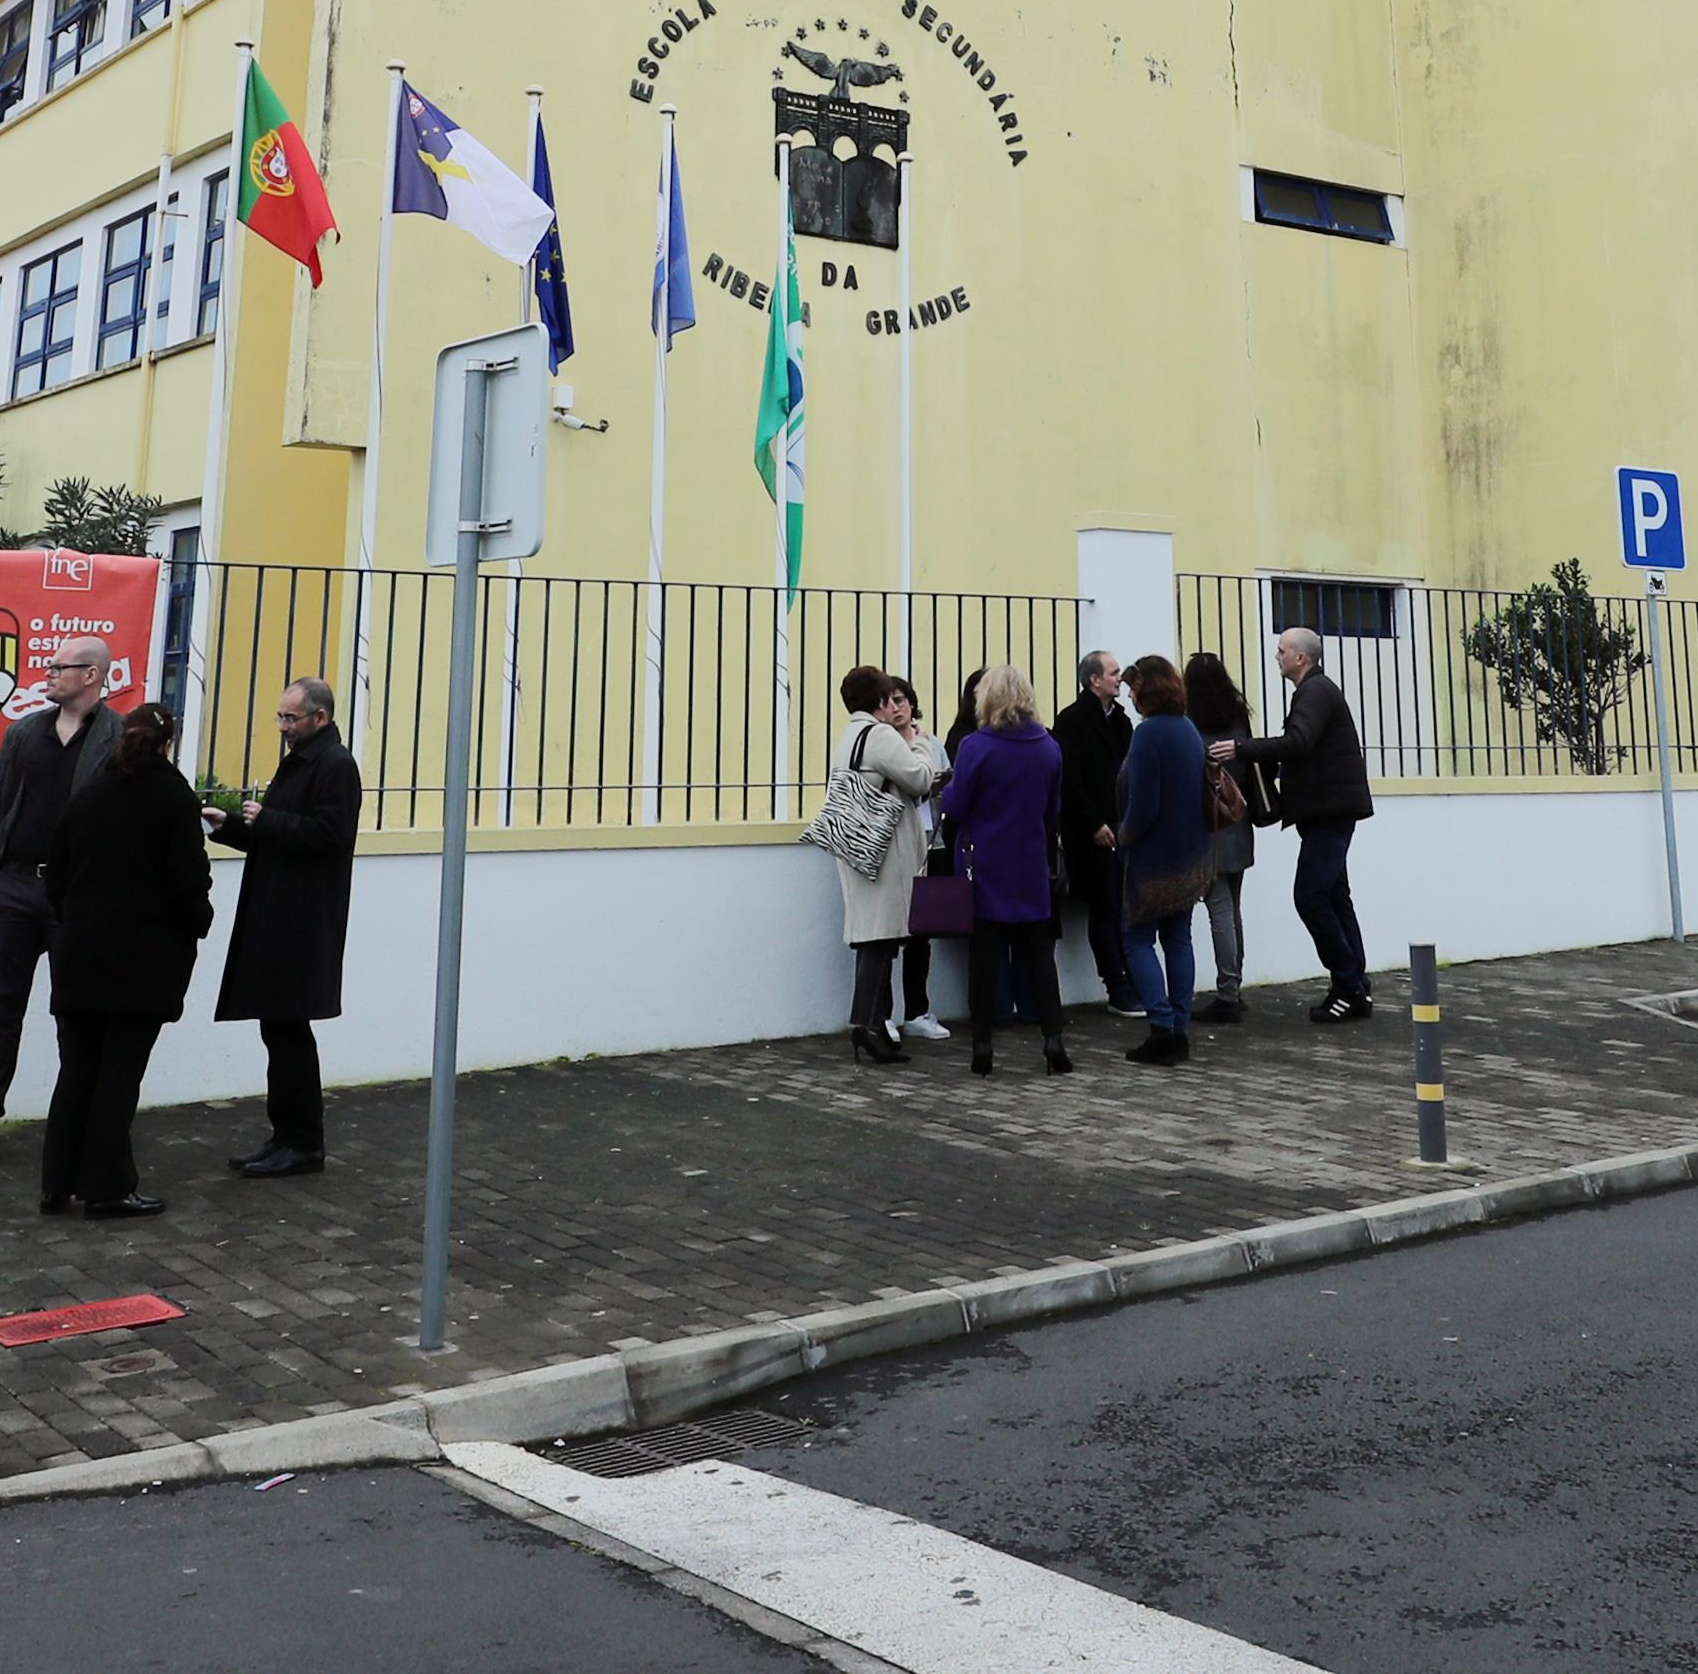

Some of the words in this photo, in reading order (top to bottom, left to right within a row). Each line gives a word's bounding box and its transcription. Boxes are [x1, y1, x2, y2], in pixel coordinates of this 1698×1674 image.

[702, 252, 812, 328] RIBEA
[821, 262, 858, 290] DA
[1631, 478, 1668, 557] P
[50, 549, 88, 581] fne
[30, 618, 44, 631] o
[51, 613, 114, 633] futuro
